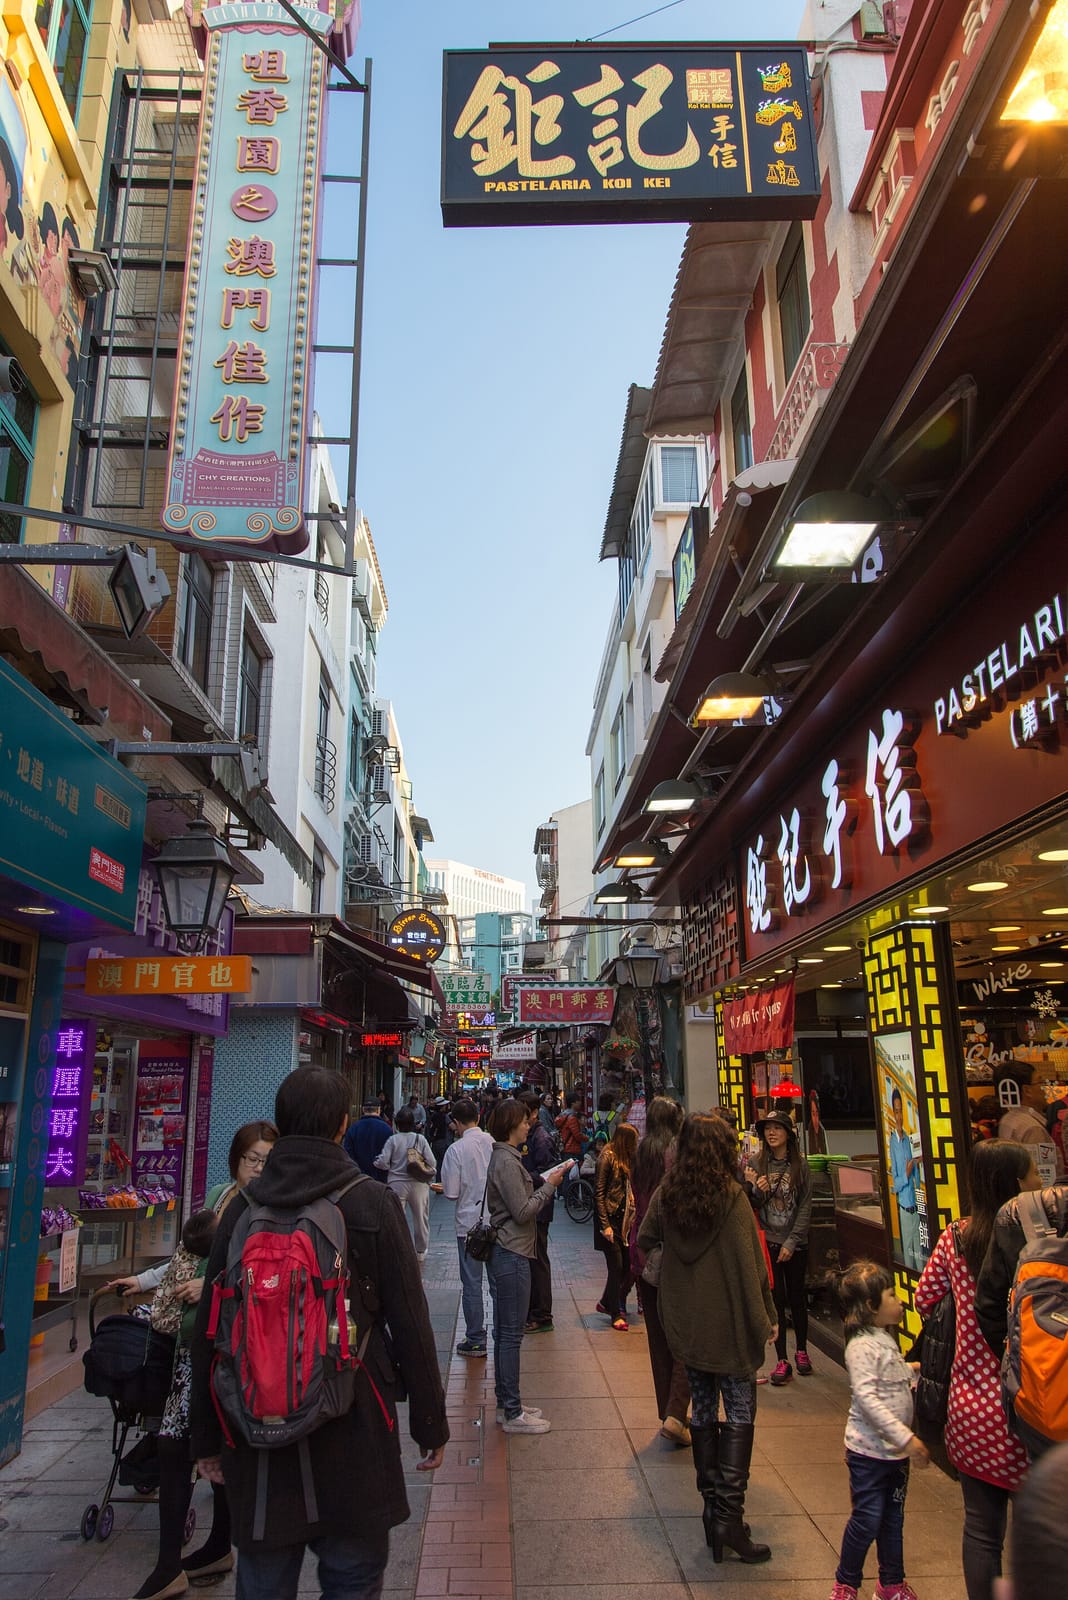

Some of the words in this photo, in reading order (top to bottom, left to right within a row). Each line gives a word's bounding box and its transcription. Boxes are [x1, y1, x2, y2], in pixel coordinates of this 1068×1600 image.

[453, 60, 700, 177] 鉅記
[708, 115, 738, 168] 手信
[484, 179, 591, 192] PASTELARIA
[602, 178, 632, 189] KOI
[643, 177, 671, 188] KEI
[210, 49, 289, 442] 咀香園之澳門佳作
[219, 475, 272, 483] CREATIONS
[97, 962, 233, 989] 澳門官也
[441, 975, 486, 990] 福臨居
[972, 963, 1032, 1001] White
[526, 991, 609, 1010] 澳門郵票
[46, 1028, 84, 1178] 車厘哥夫
